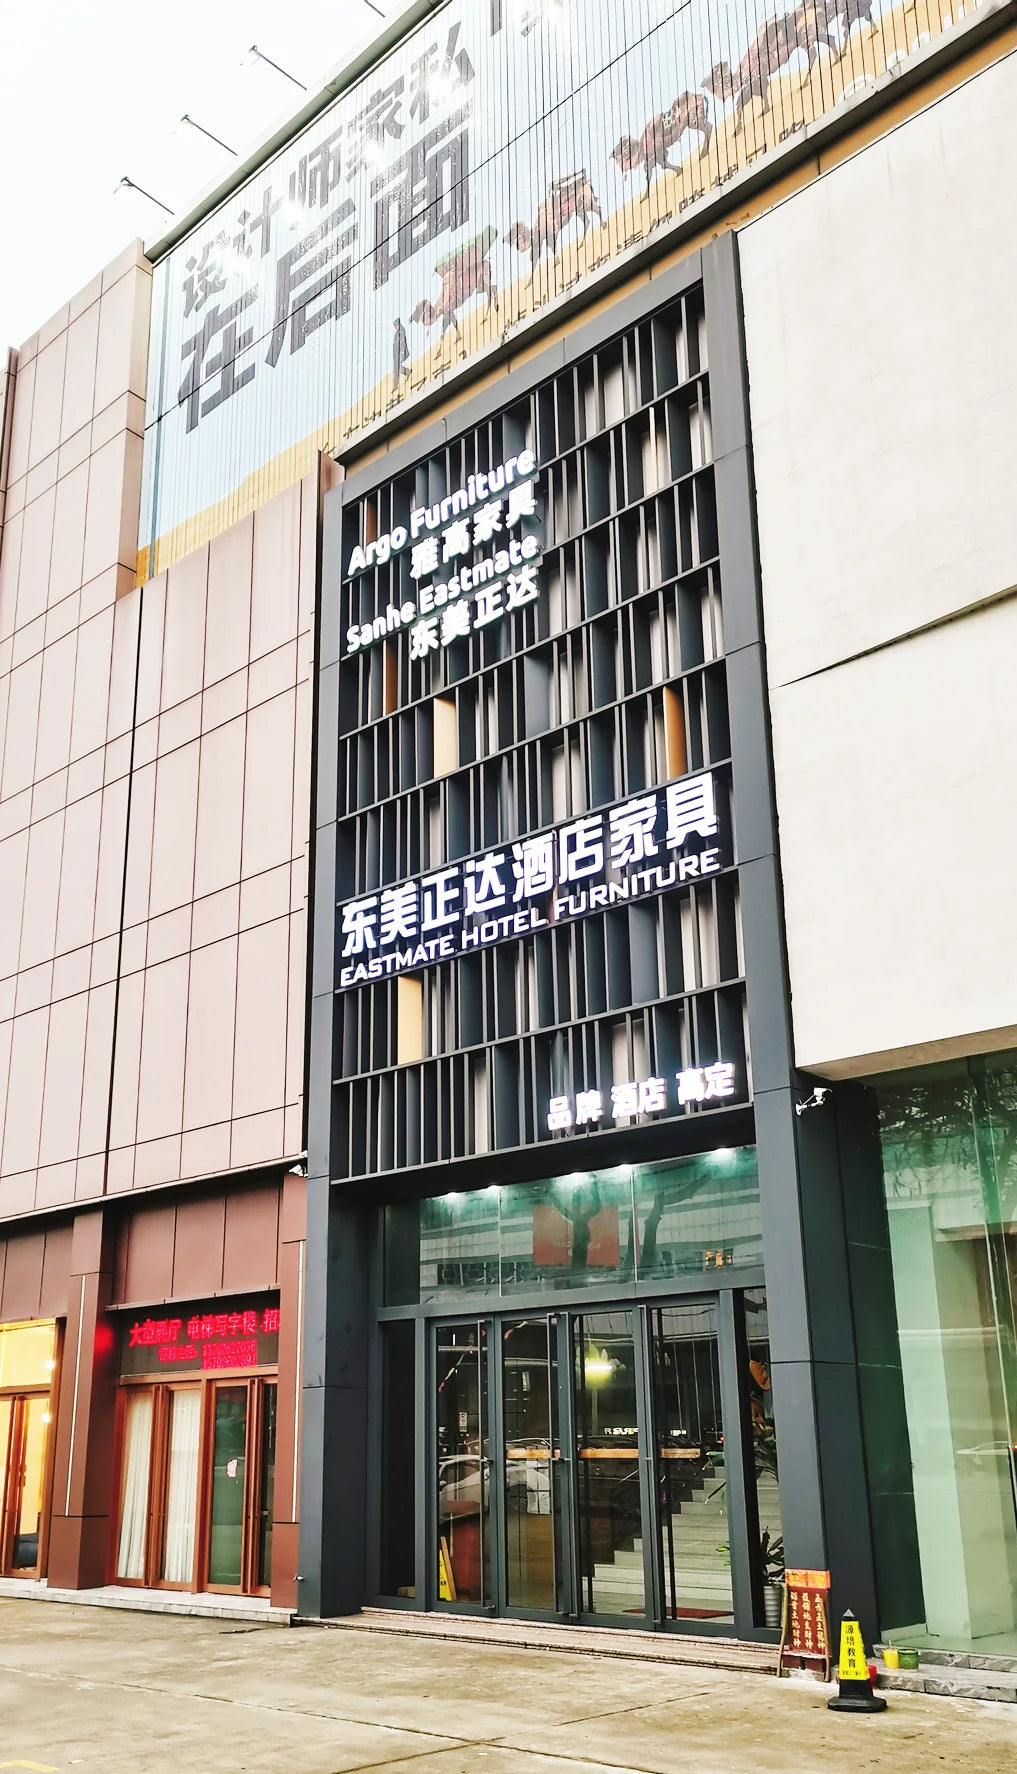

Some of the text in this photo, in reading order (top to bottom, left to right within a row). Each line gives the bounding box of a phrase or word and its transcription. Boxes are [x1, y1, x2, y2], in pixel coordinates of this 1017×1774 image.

[347, 448, 535, 576] Argo Furniture
[410, 479, 536, 579] 雅高家具
[346, 535, 537, 653] Sanhe Eastmate
[409, 564, 538, 661] 东美正达
[340, 847, 720, 987] EASTMATE HOTEL FURNITURE
[341, 772, 718, 957] 东美正达酒店家具
[547, 1062, 735, 1131] 品牌 酒店 高定
